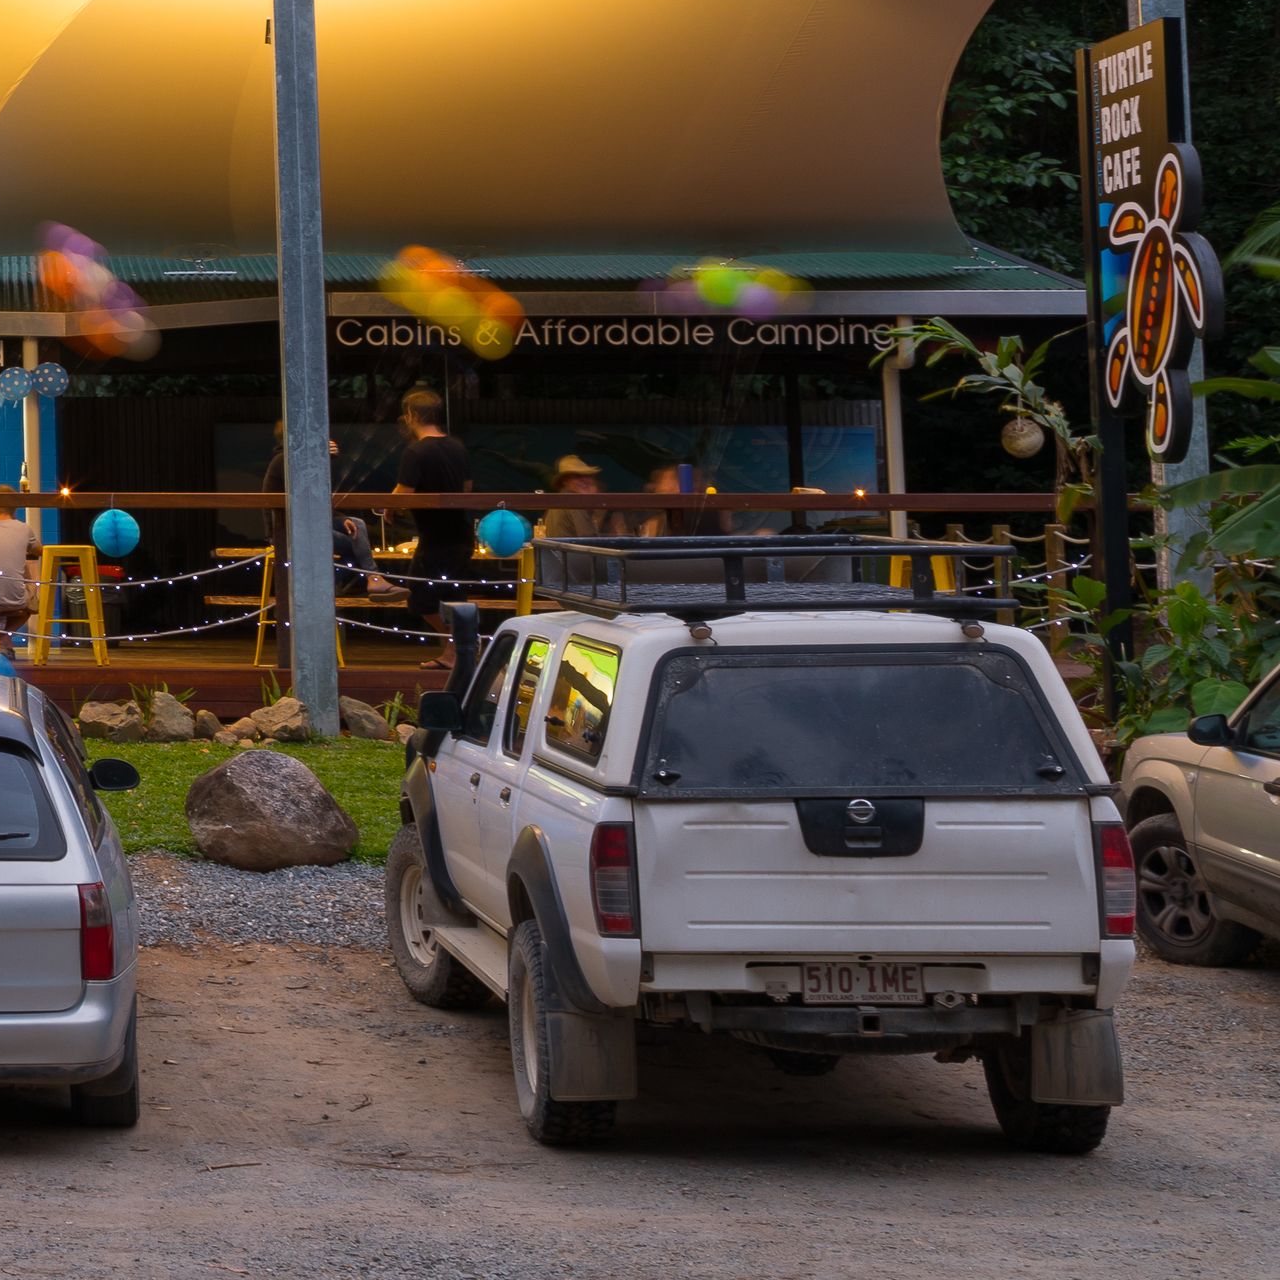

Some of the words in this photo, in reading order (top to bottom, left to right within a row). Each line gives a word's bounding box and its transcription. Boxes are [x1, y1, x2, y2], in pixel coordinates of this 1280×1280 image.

[1099, 41, 1153, 96] TURTLE
[1101, 95, 1142, 145] ROCK
[1103, 146, 1142, 194] CAFE
[336, 319, 461, 346] Cabins
[476, 319, 501, 345] &
[515, 319, 714, 346] Affordable
[727, 319, 896, 353] Camping
